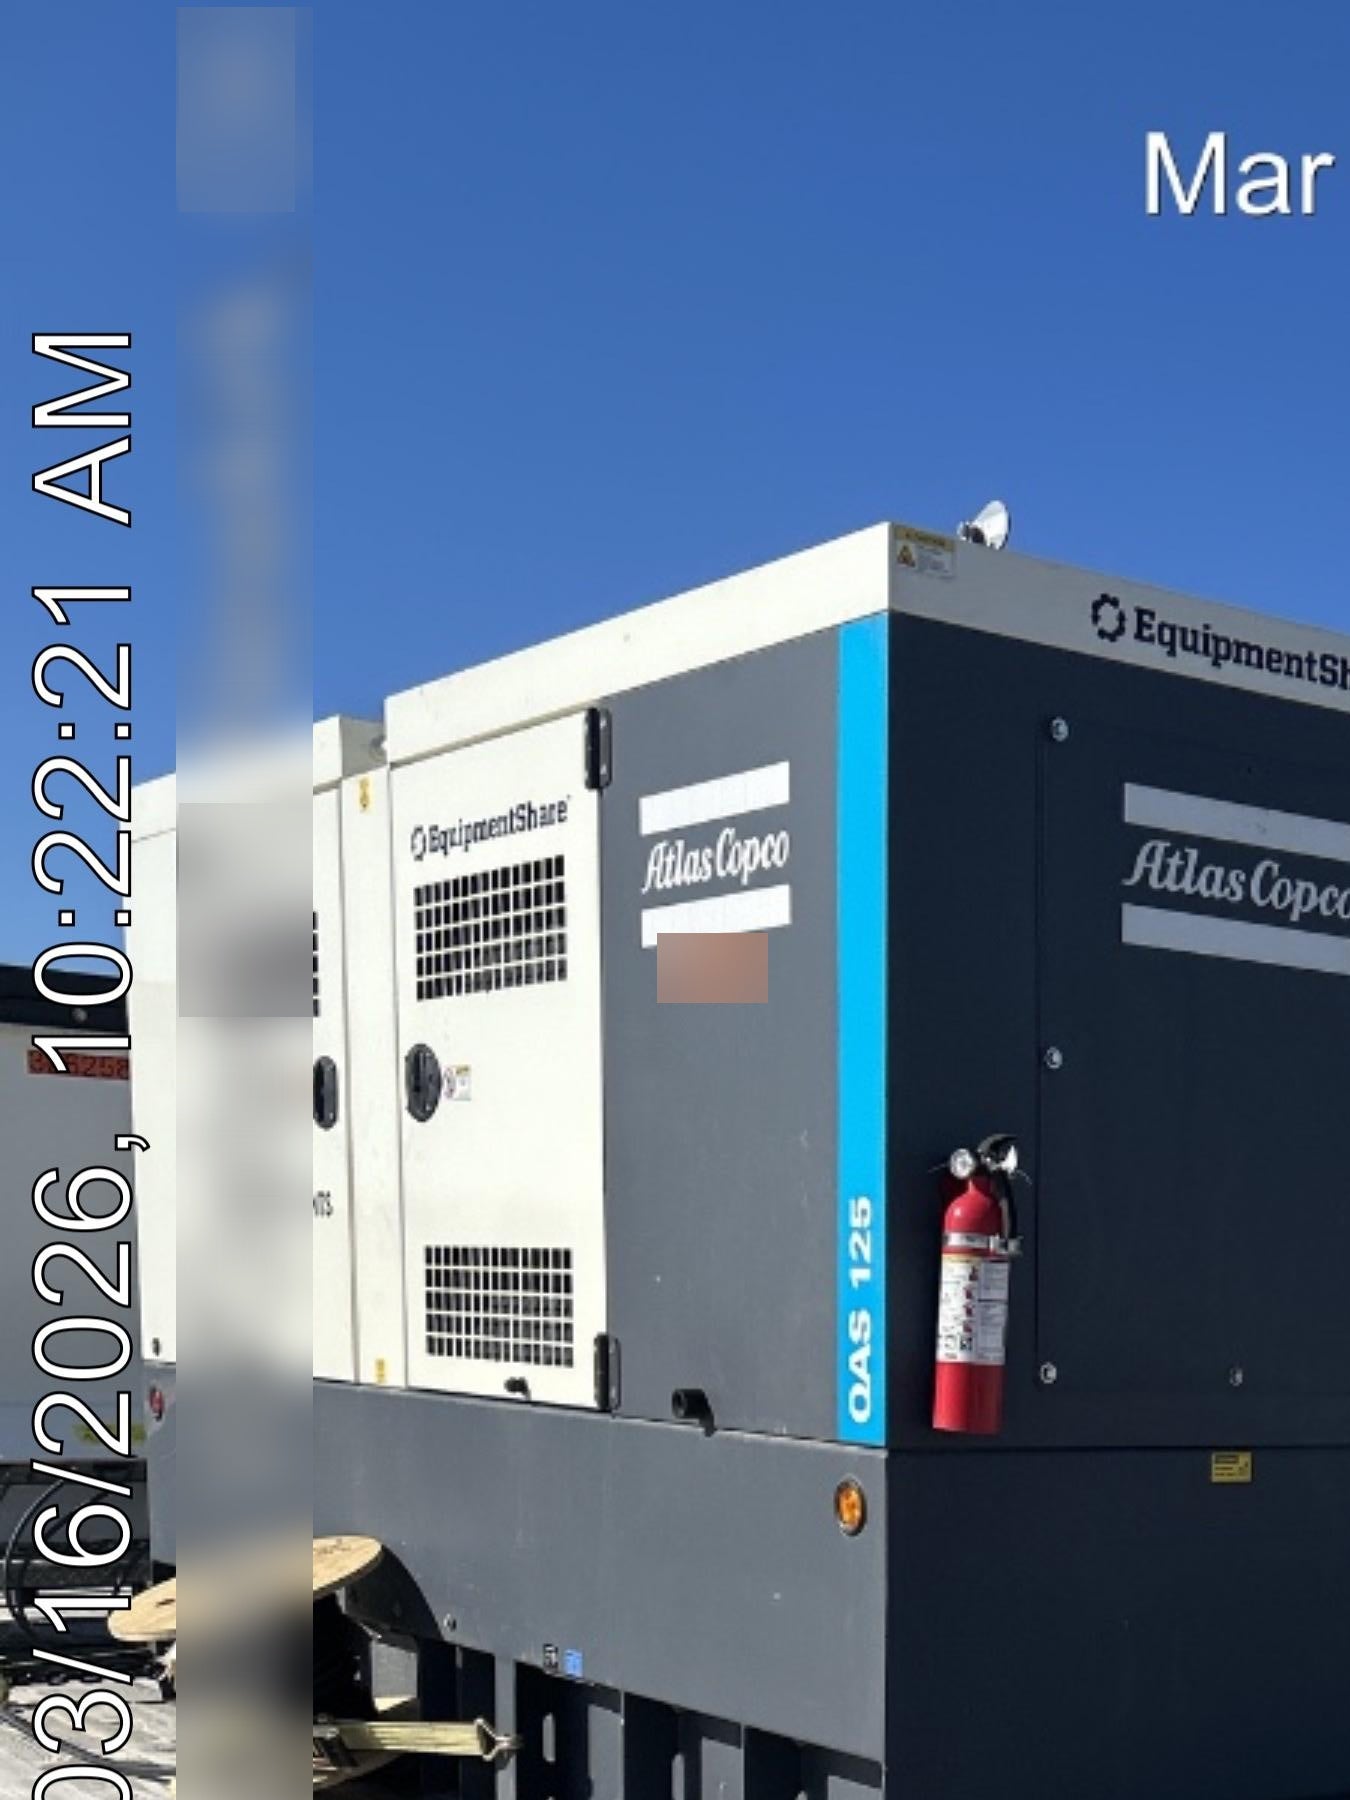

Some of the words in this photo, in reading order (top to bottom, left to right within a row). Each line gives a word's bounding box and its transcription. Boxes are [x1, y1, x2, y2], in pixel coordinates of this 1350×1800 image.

[428, 800, 568, 857] EquipmentShare
[641, 838, 712, 895] Atlas
[715, 826, 790, 887] Copco
[1122, 838, 1246, 902] Atlas
[848, 1196, 871, 1290] 125
